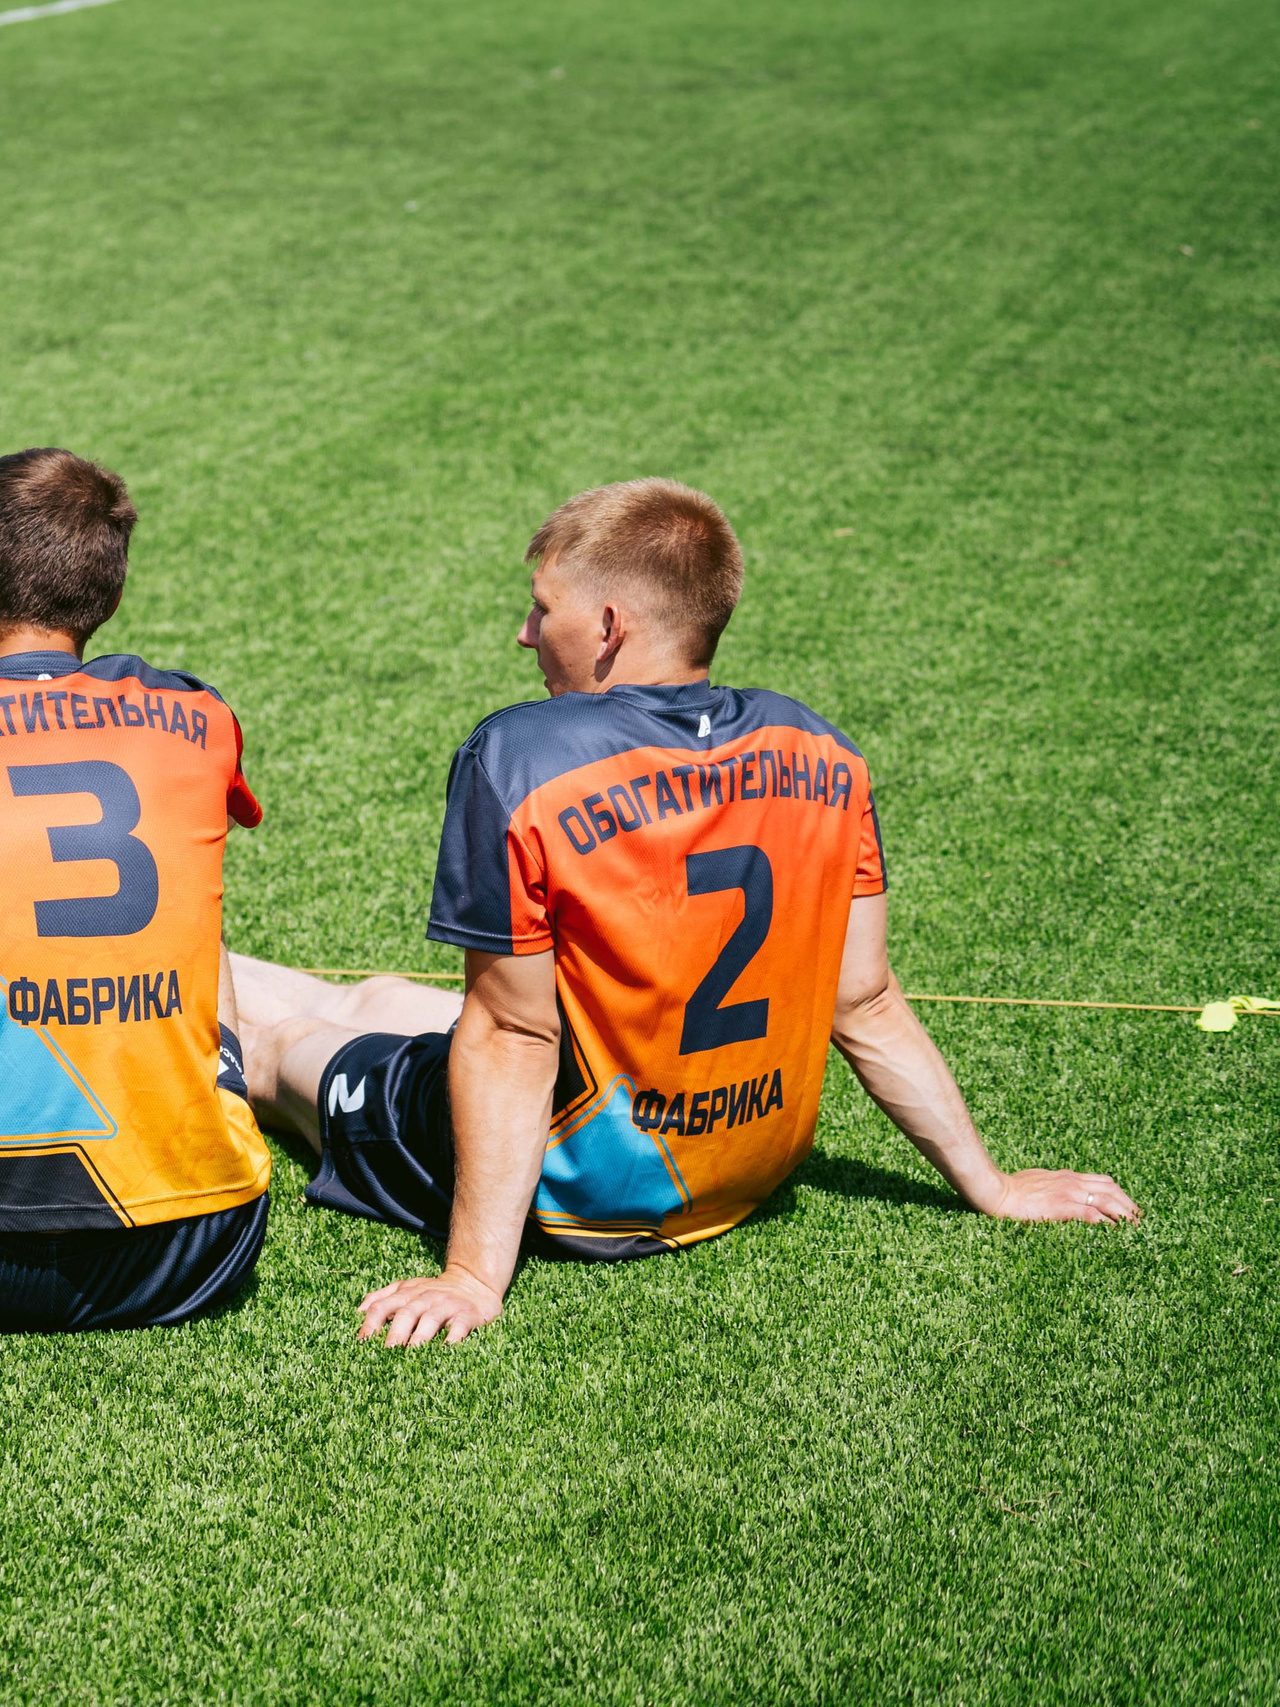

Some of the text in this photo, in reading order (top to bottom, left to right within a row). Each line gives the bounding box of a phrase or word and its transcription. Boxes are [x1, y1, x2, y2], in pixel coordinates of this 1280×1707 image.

[7, 760, 159, 938] 3
[558, 750, 853, 855] ОБОГАТИТЕЛЬНАЯ
[6, 969, 183, 1026] ФАБРИКА
[679, 844, 774, 1057] 2
[632, 1069, 784, 1138] ФАБРИКА
